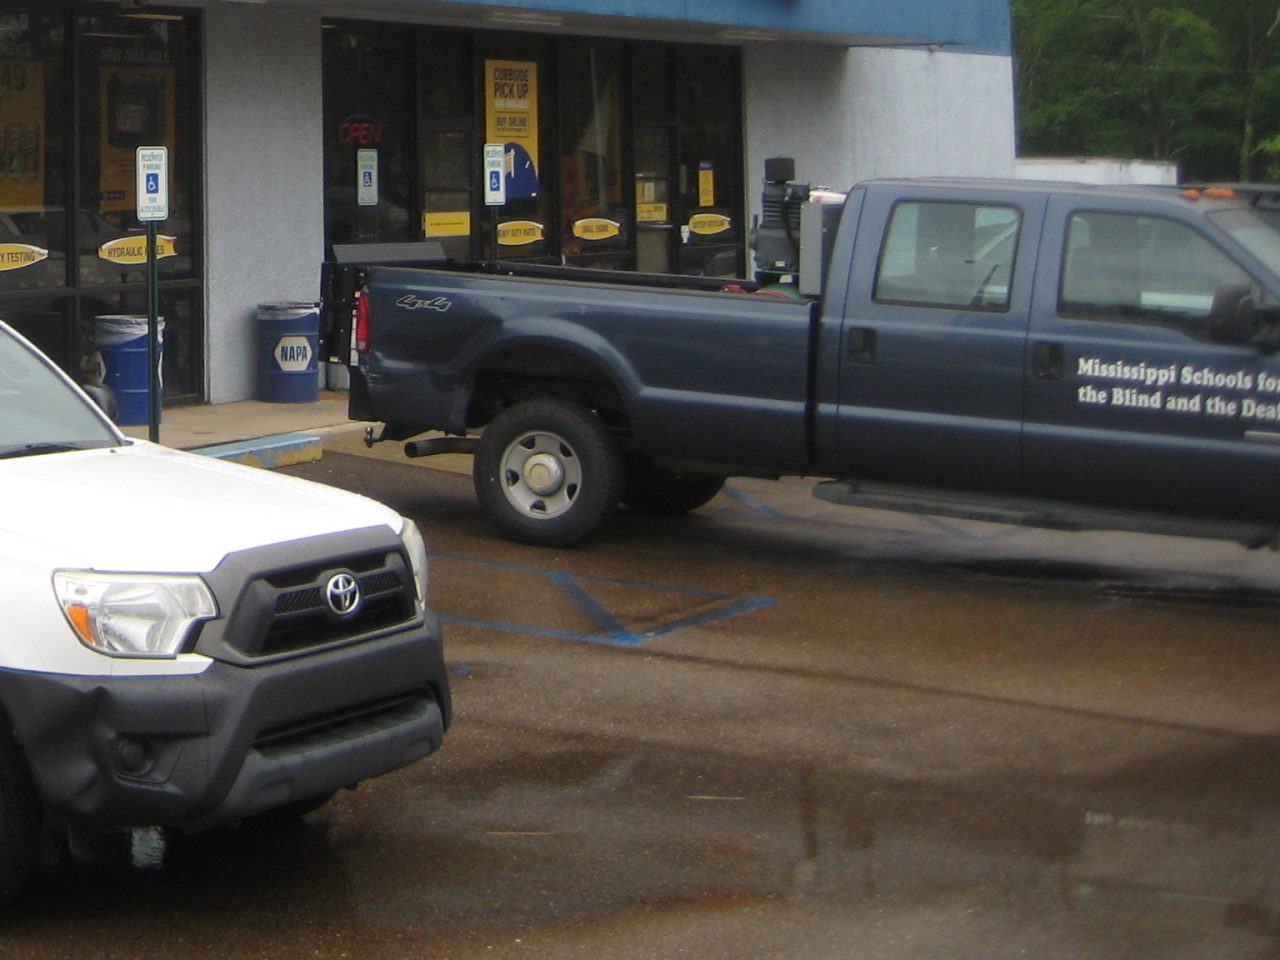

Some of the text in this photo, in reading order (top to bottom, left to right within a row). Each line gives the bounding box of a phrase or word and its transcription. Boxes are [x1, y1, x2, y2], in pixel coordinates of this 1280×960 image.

[494, 67, 528, 82] CURBSIDE
[494, 82, 528, 98] PICK UP
[339, 122, 383, 145] OPEN
[7, 251, 35, 263] TESTING
[107, 246, 143, 258] HYDRAULIC
[395, 294, 452, 312] 4x4
[280, 345, 308, 362] NAPA
[1077, 357, 1176, 386] Mississippi
[1181, 365, 1253, 390] Schools
[1077, 385, 1108, 404] the
[1111, 387, 1161, 409] Blind
[1165, 393, 1202, 413] and
[1206, 396, 1237, 416] the
